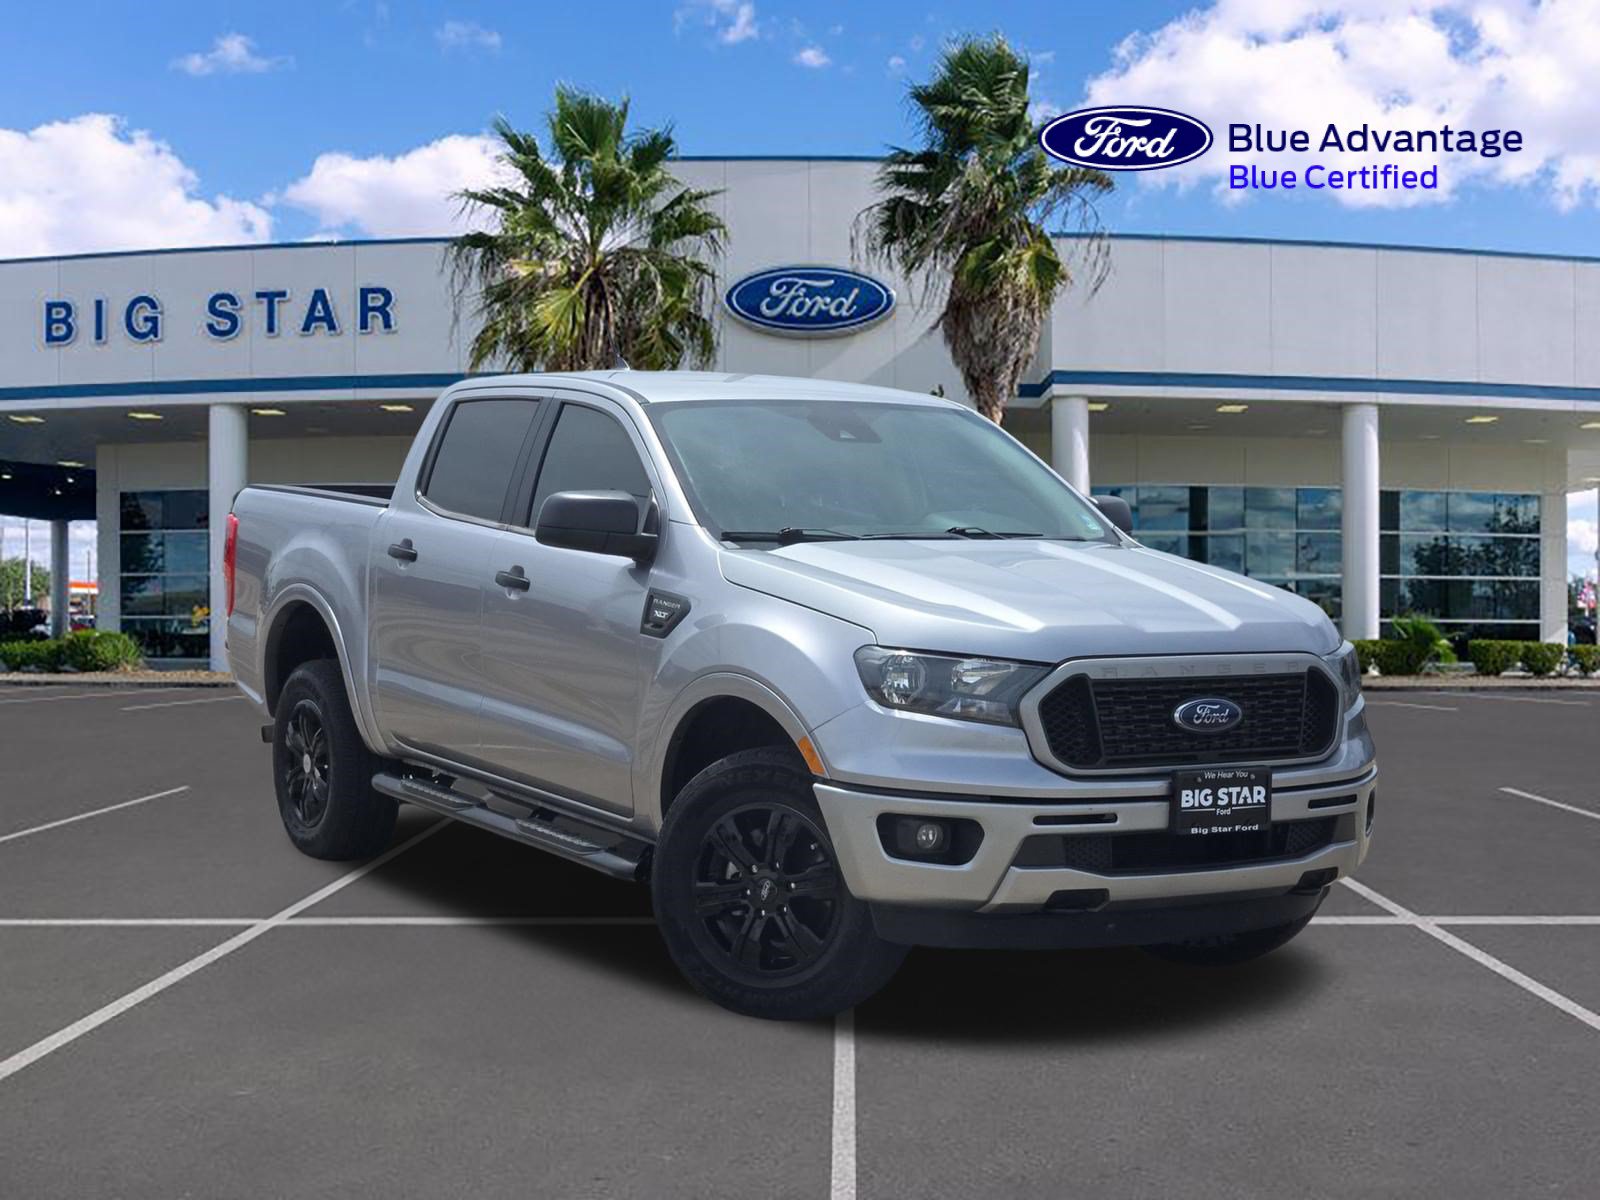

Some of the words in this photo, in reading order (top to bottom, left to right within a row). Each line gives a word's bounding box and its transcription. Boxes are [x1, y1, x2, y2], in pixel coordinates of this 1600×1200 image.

[759, 277, 859, 318] Ford
[44, 295, 163, 345] BIG
[206, 287, 397, 340] STAR
[653, 598, 681, 609] RANGER
[1193, 704, 1230, 725] Ford
[1204, 771, 1217, 779] We
[1217, 771, 1235, 779] Hear
[1236, 770, 1249, 778] You
[1181, 788, 1214, 808] BIG
[1217, 785, 1266, 806] STAR
[1191, 827, 1209, 835] Big
[1211, 825, 1233, 833] Star
[1235, 823, 1259, 832] Ford
